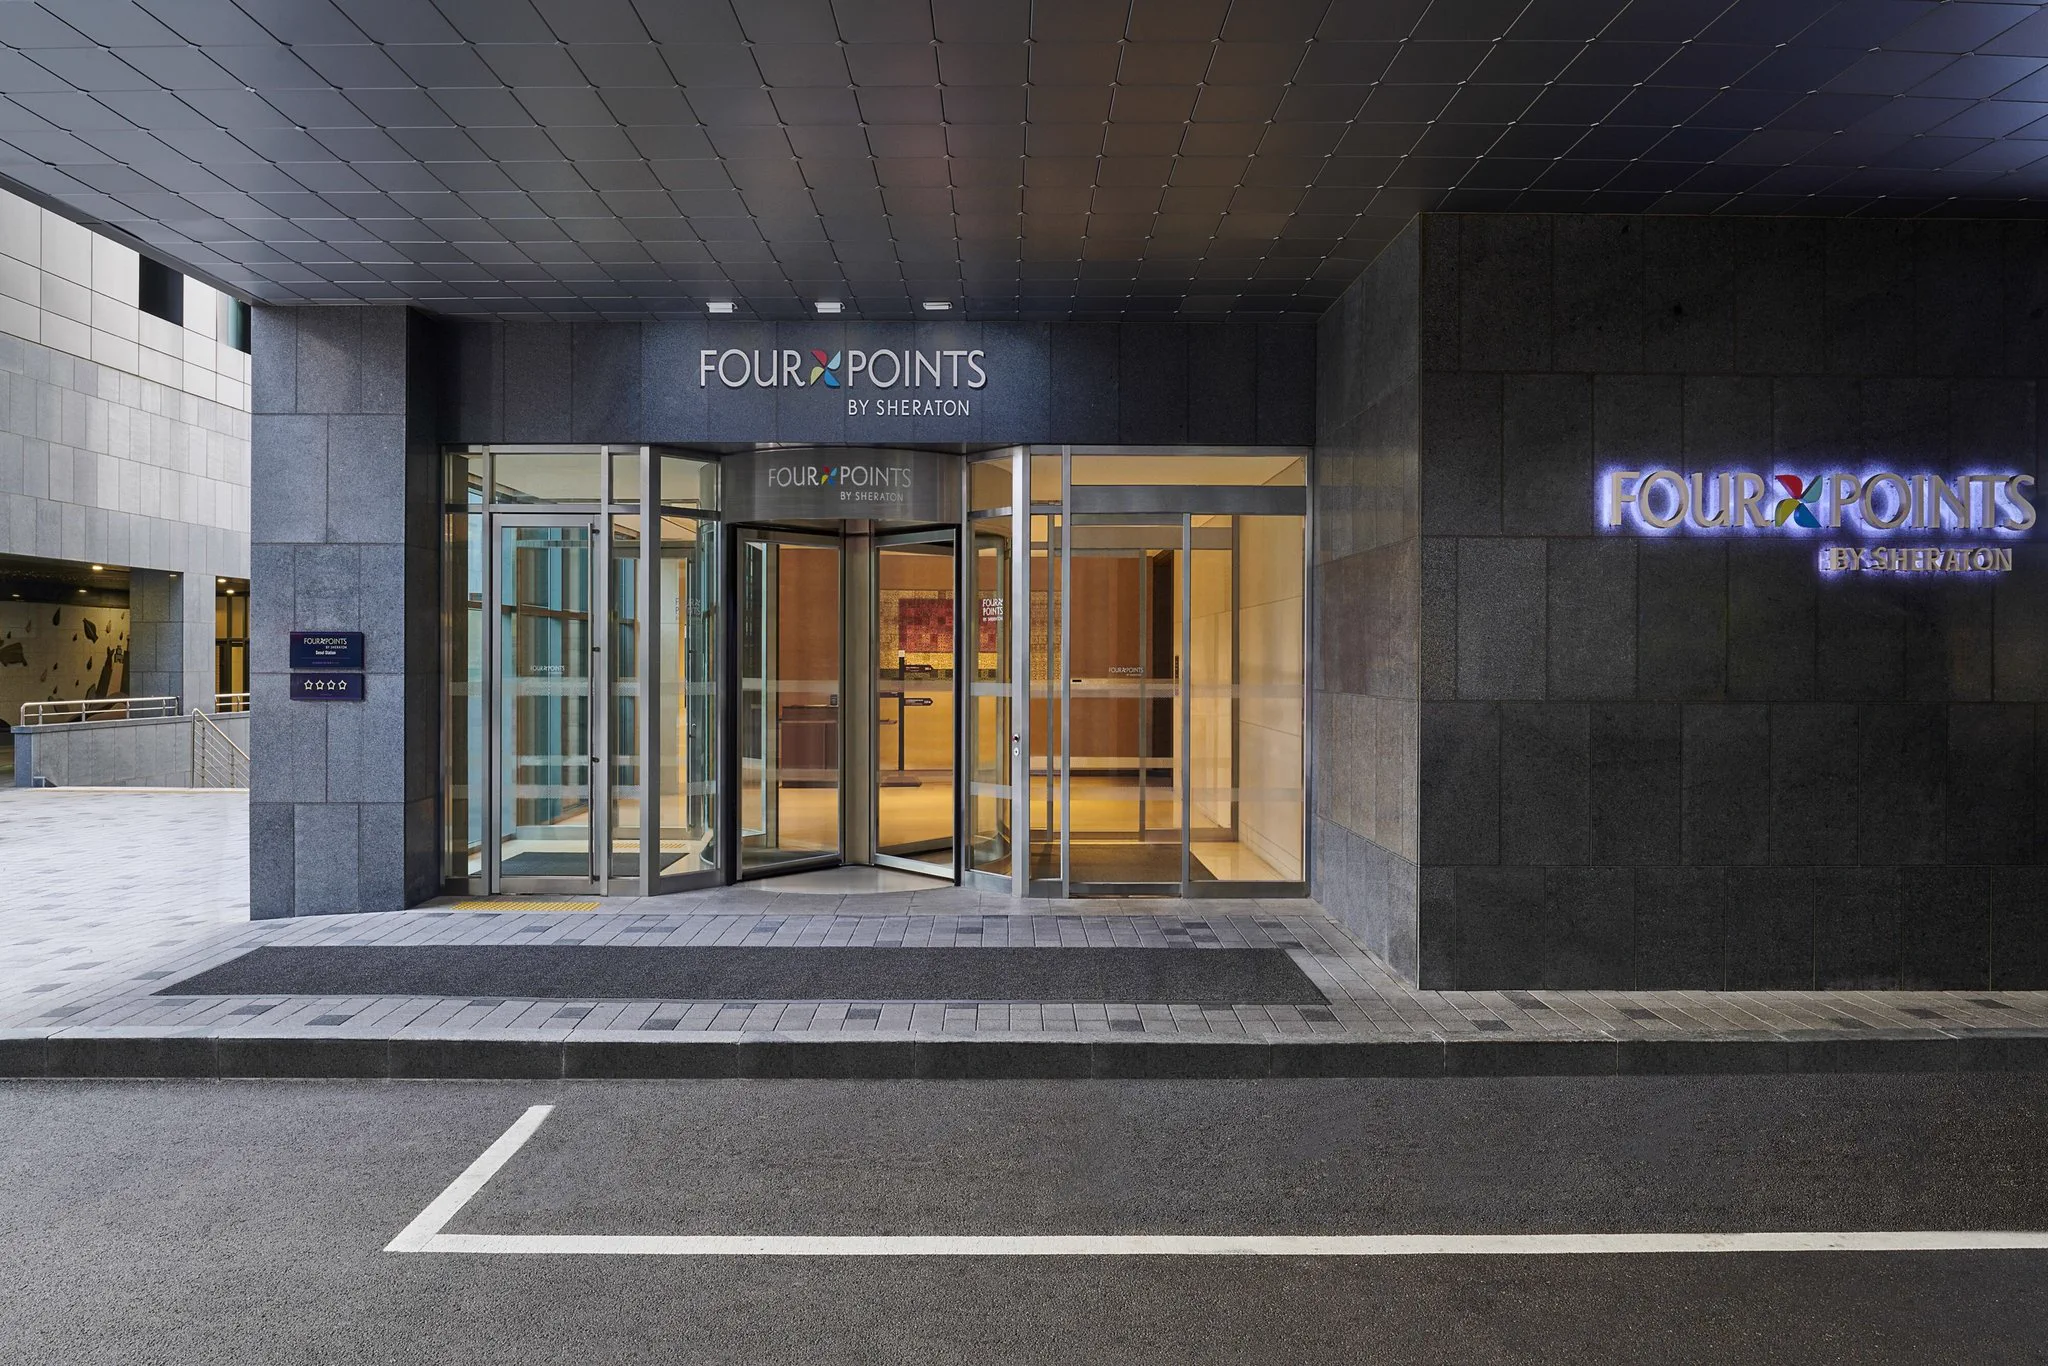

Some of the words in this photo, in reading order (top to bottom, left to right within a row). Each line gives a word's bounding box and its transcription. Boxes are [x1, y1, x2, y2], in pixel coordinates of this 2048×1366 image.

[700, 349, 806, 388] FOUR
[848, 349, 987, 389] POINTS
[848, 399, 870, 416] BY
[876, 399, 970, 417] SHERATON
[768, 466, 820, 488] FOUR
[840, 466, 912, 488] POINTS
[840, 491, 852, 501] BY
[855, 491, 904, 502] SHERATON
[1610, 470, 1772, 529] FOUR
[1829, 472, 2037, 531] POINTS
[1829, 547, 1866, 571] BY
[1870, 546, 2013, 572] SHERATON
[982, 607, 1004, 616] POINTS
[983, 598, 997, 607] FOUR
